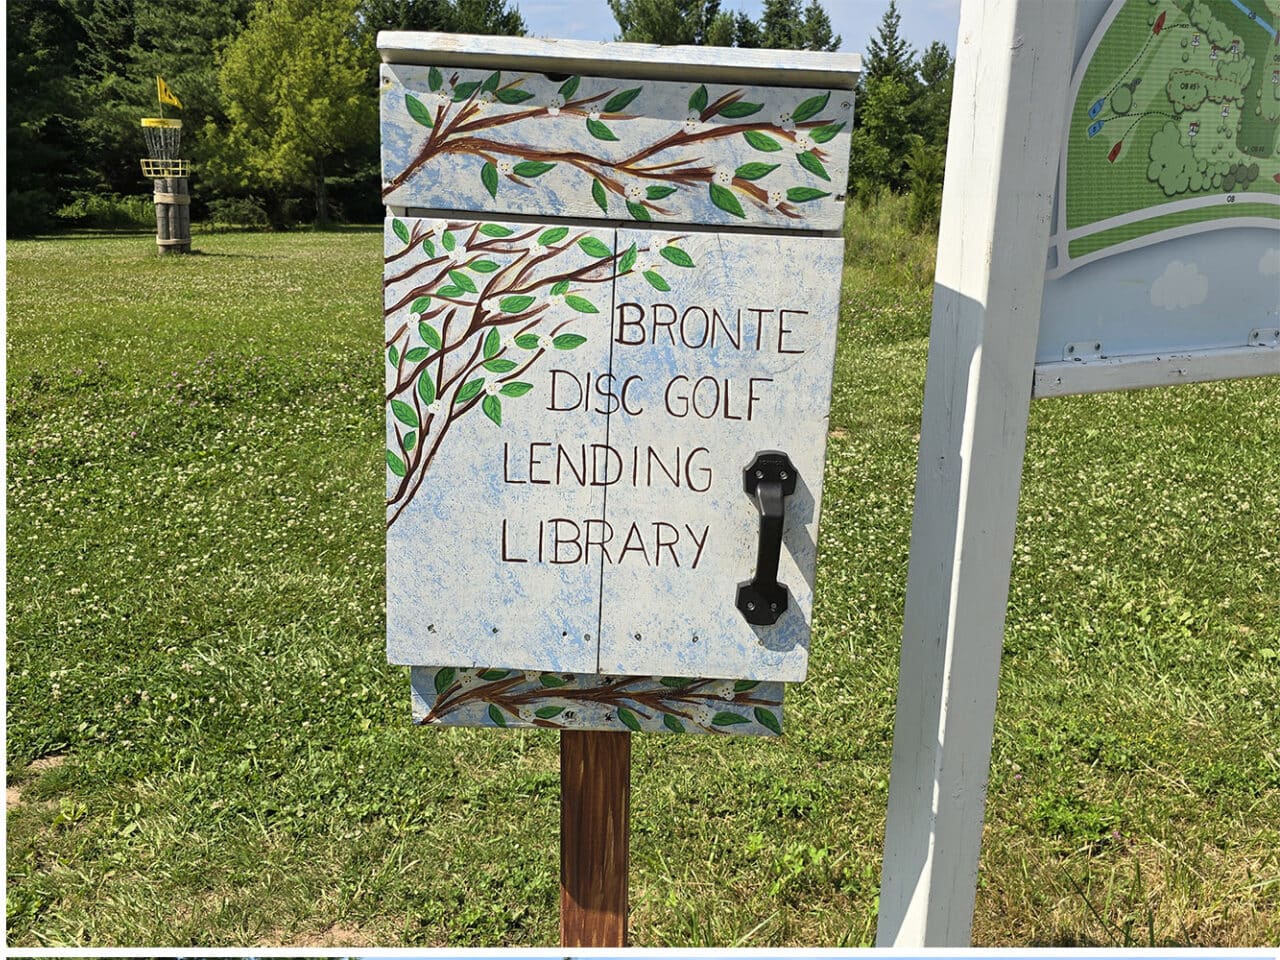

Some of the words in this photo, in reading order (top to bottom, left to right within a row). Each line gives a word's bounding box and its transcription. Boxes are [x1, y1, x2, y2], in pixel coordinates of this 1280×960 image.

[615, 302, 809, 354] BRONTE
[545, 368, 644, 416] DISC
[664, 375, 774, 422] GOLF
[503, 442, 713, 493] LENDING
[500, 518, 710, 570] LIBRARY
